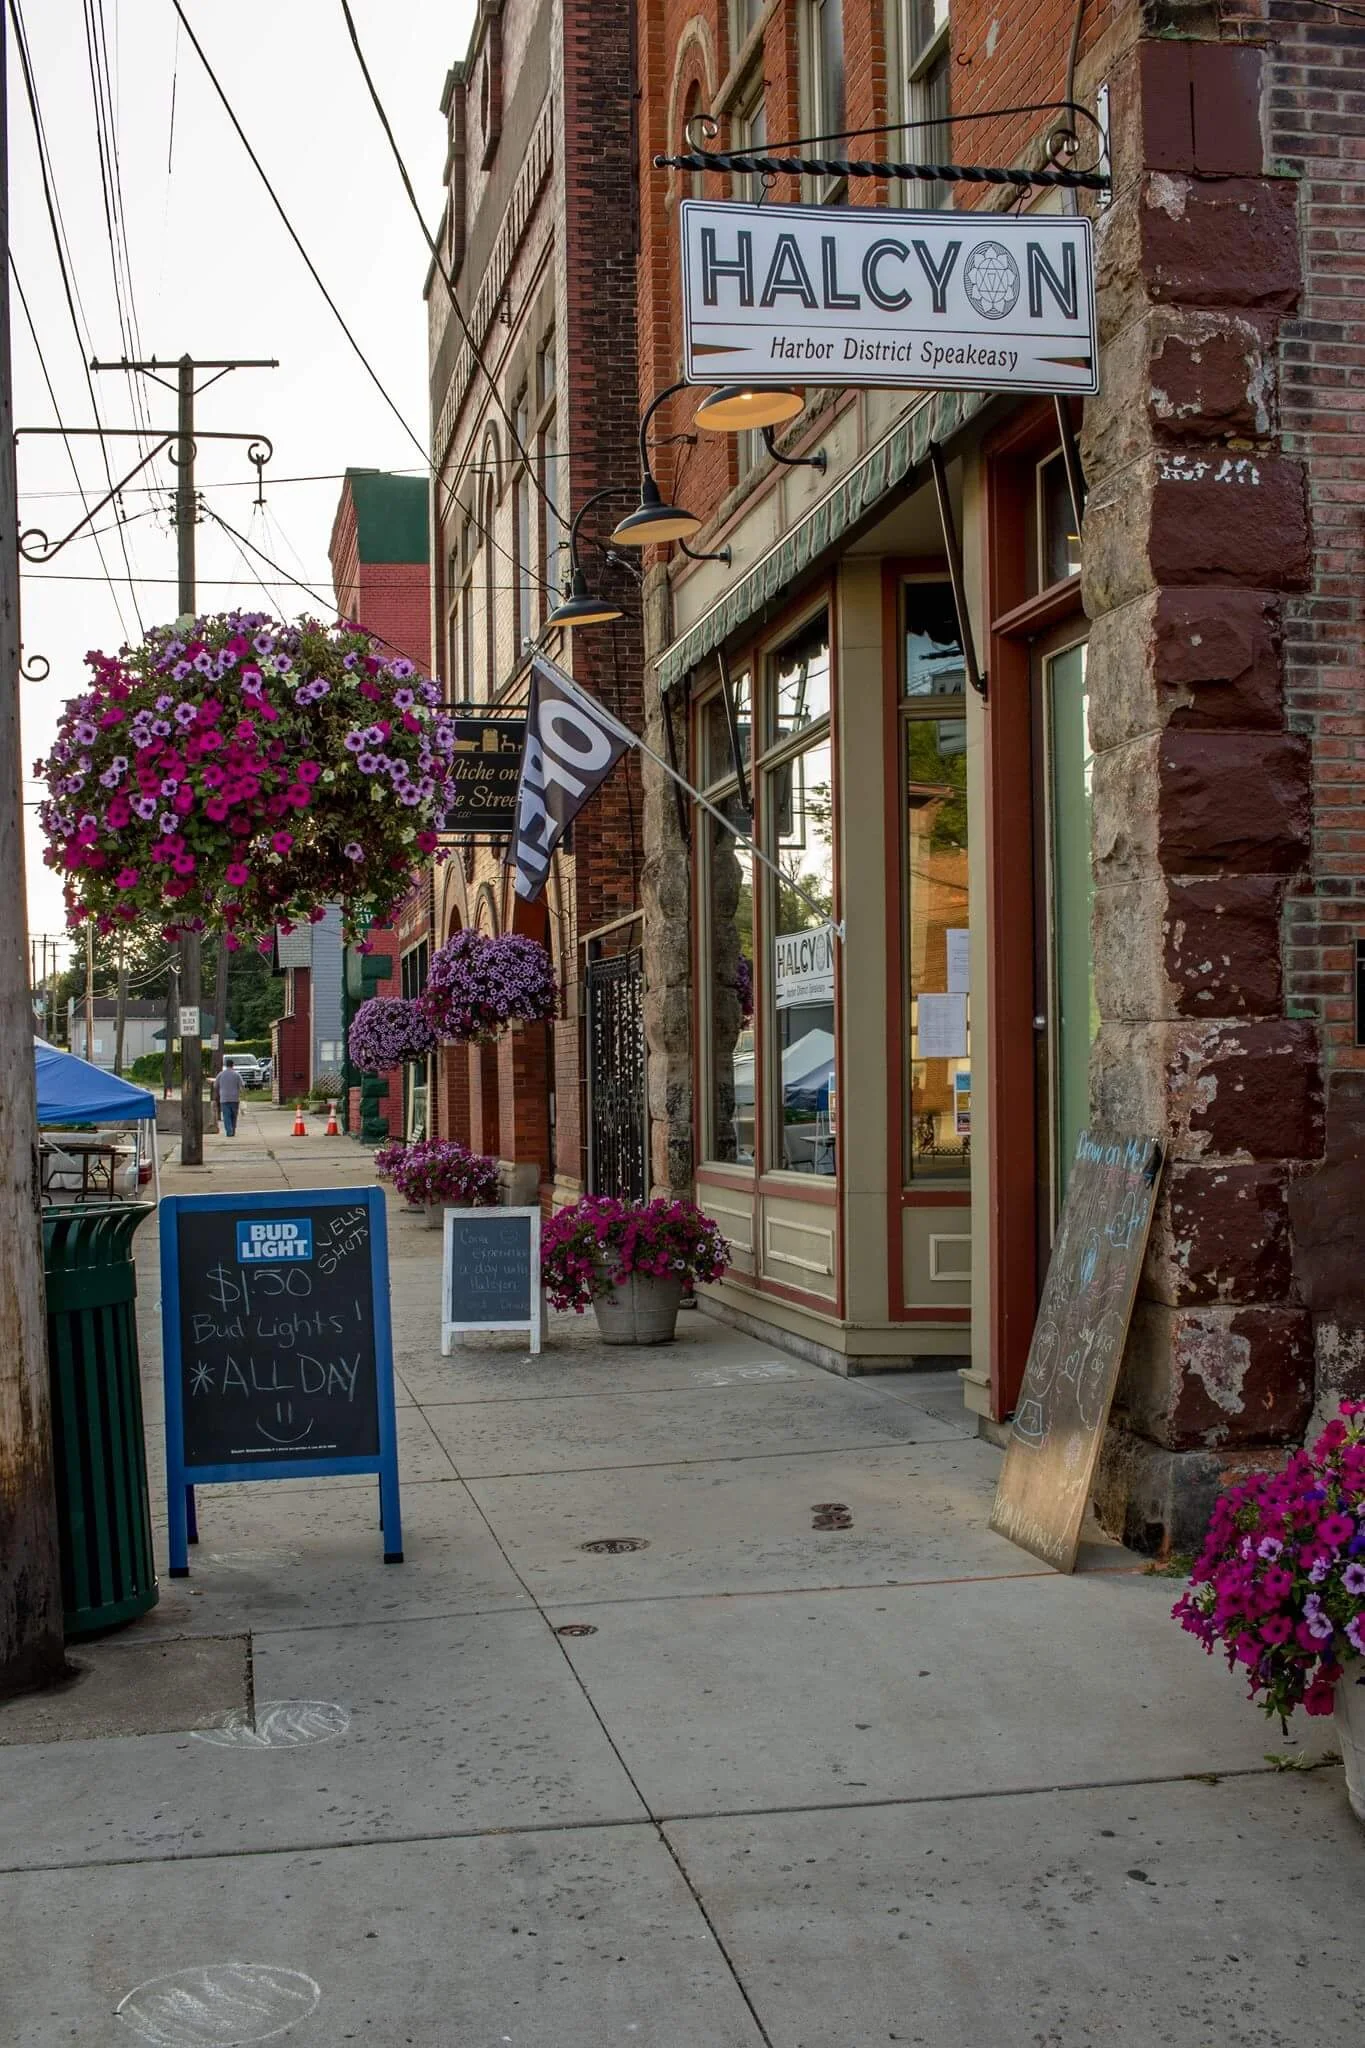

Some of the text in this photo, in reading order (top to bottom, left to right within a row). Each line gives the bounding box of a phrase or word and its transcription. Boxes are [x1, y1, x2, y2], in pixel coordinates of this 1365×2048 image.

[700, 226, 1080, 321] HALCYON
[770, 336, 1019, 373] Harbor District Speakeasy
[499, 768, 519, 780] on
[469, 785, 517, 808] Stree
[242, 1239, 307, 1258] LIGHT
[250, 1223, 298, 1241] BUD
[206, 1262, 312, 1316] $1.50
[192, 1314, 245, 1345] Bud
[256, 1309, 344, 1349] Lights
[296, 1352, 360, 1402] DAY
